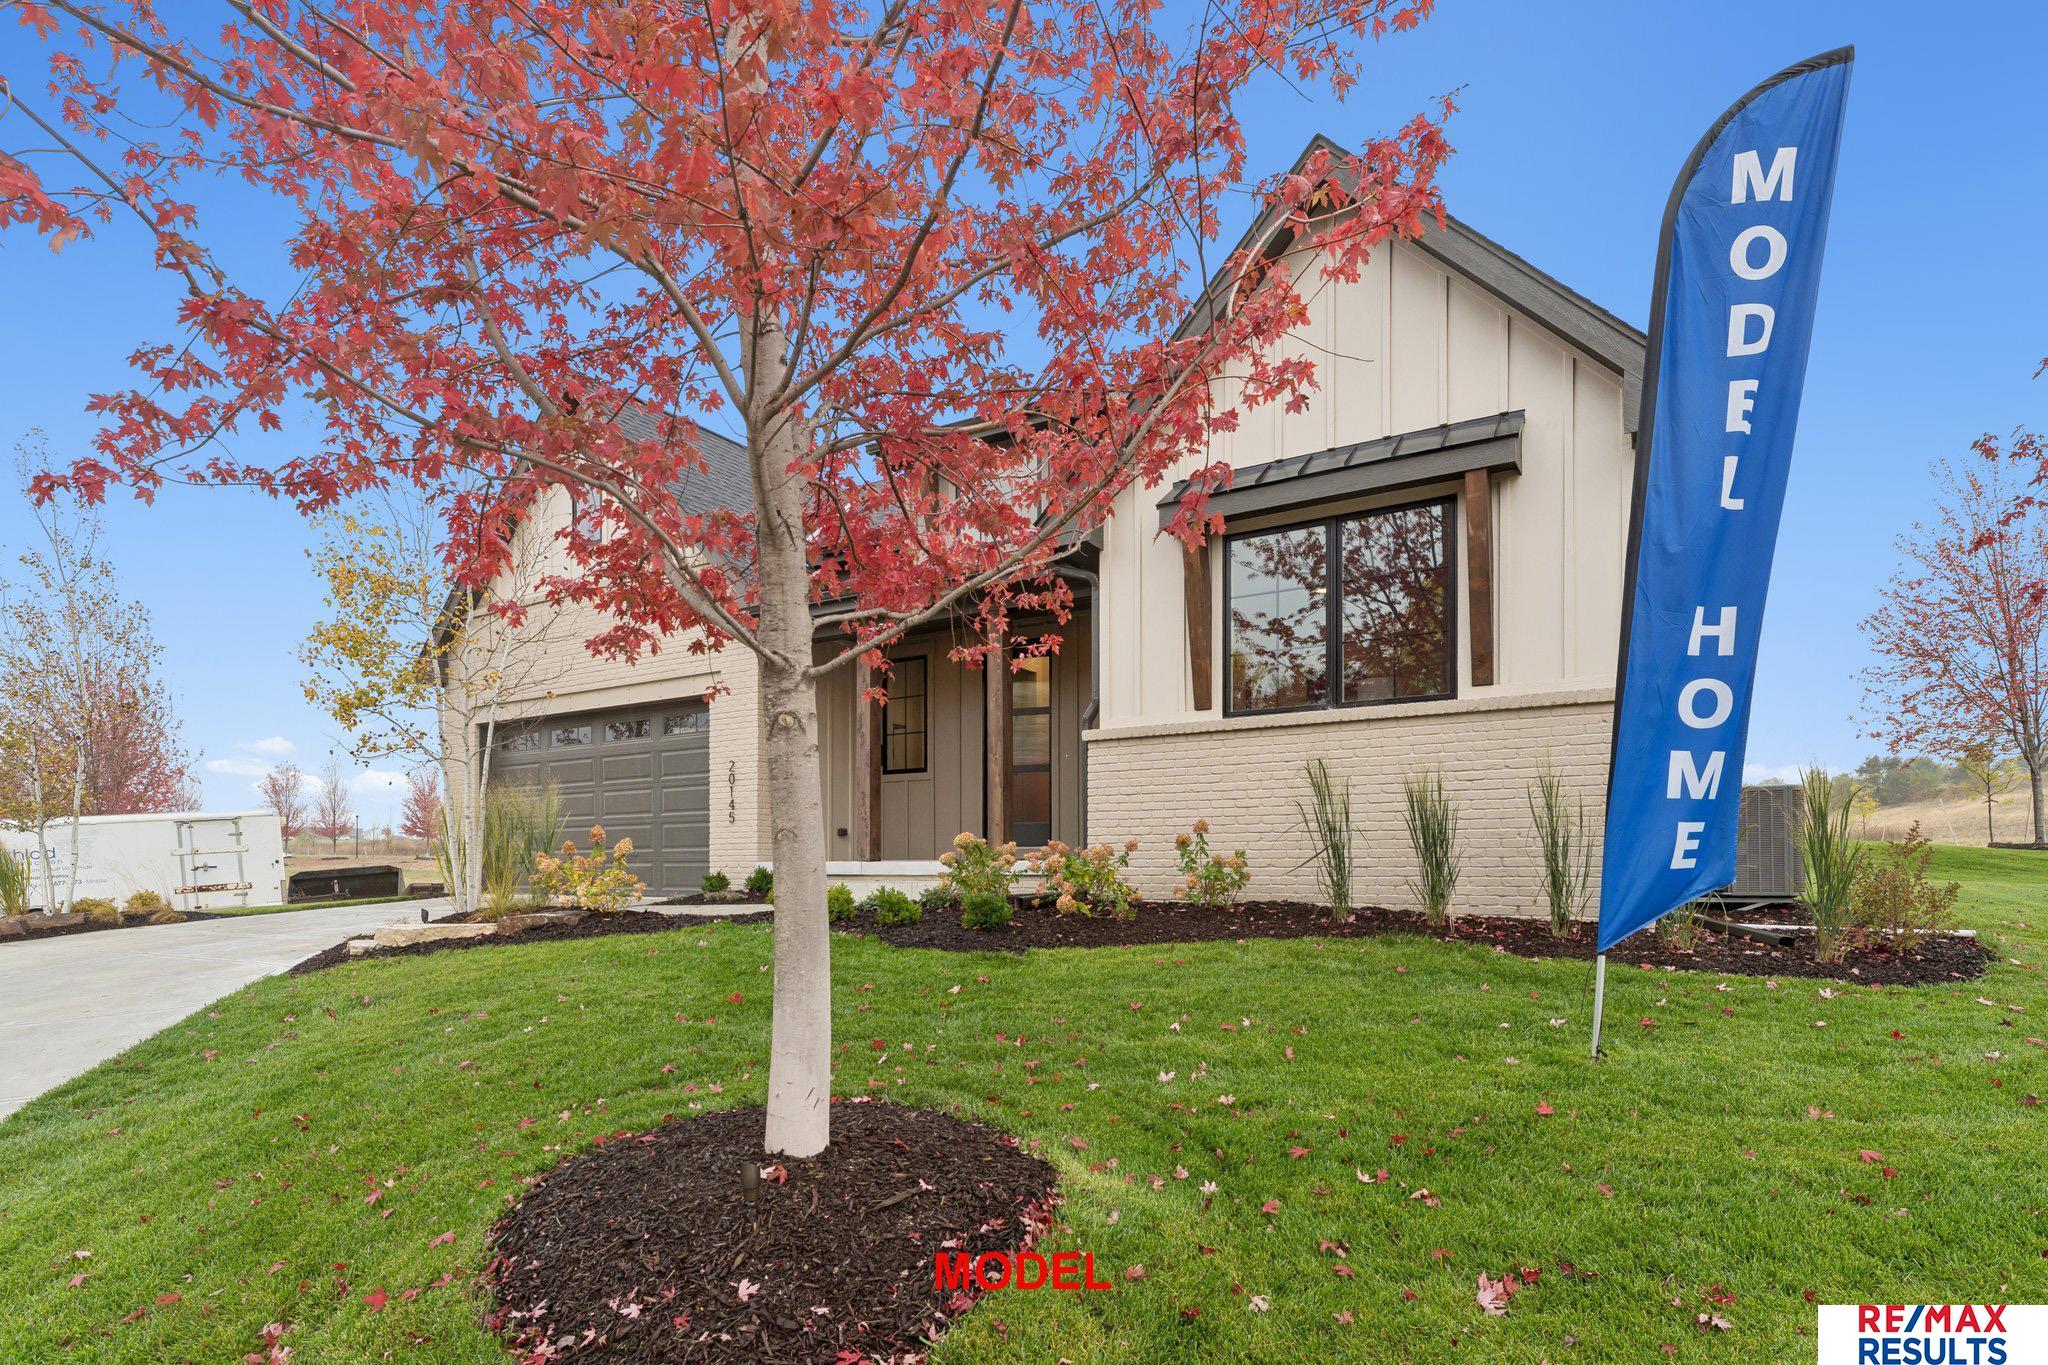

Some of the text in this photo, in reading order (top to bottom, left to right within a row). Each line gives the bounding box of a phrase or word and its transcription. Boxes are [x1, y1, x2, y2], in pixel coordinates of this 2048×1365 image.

[1666, 146, 1798, 870] MODEL HOME
[728, 760, 736, 824] 20145
